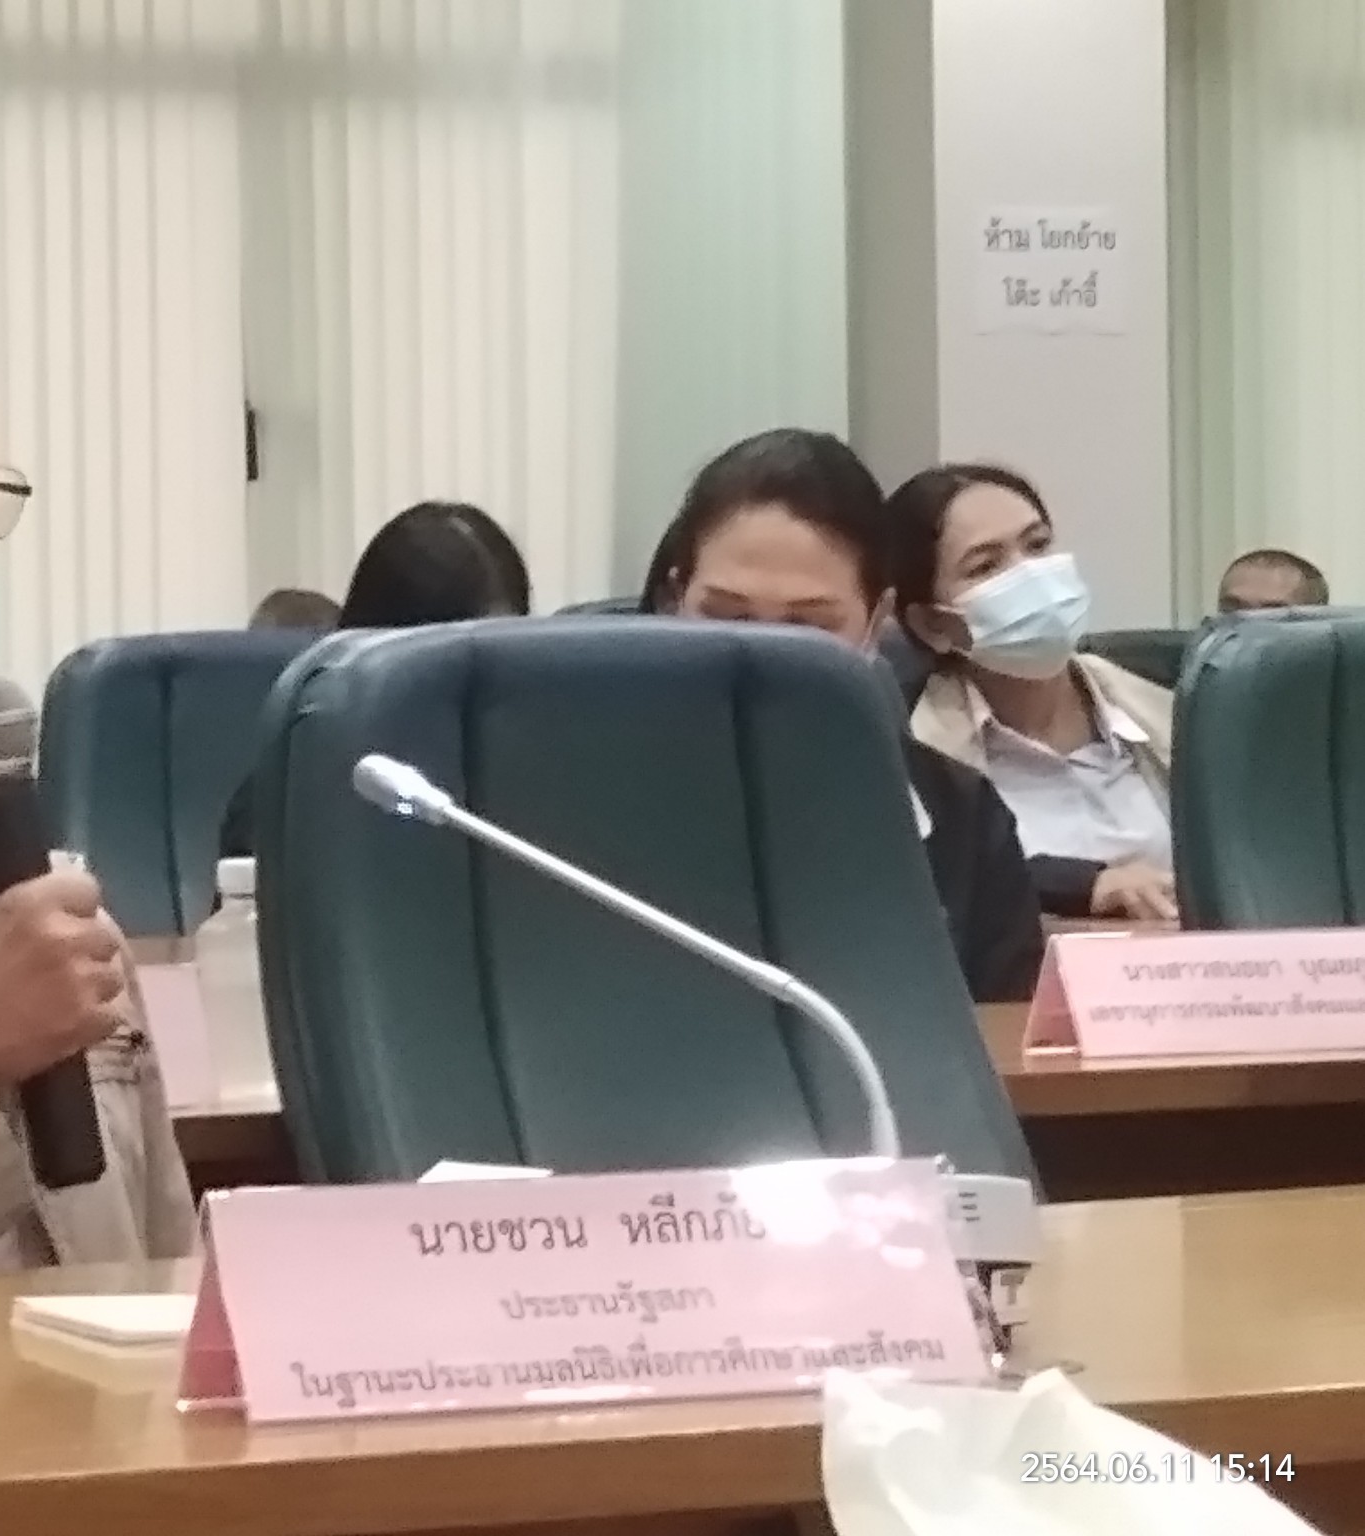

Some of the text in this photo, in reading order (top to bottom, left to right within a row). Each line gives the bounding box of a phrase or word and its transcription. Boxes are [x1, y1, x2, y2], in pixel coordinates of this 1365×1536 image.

[985, 216, 1116, 250] ห้าม โยกย้าย
[1003, 270, 1098, 307] โต๊ะ เก้าอี้
[410, 1216, 587, 1254] นายชวน
[501, 1281, 716, 1323] ประธานรัฐสภา
